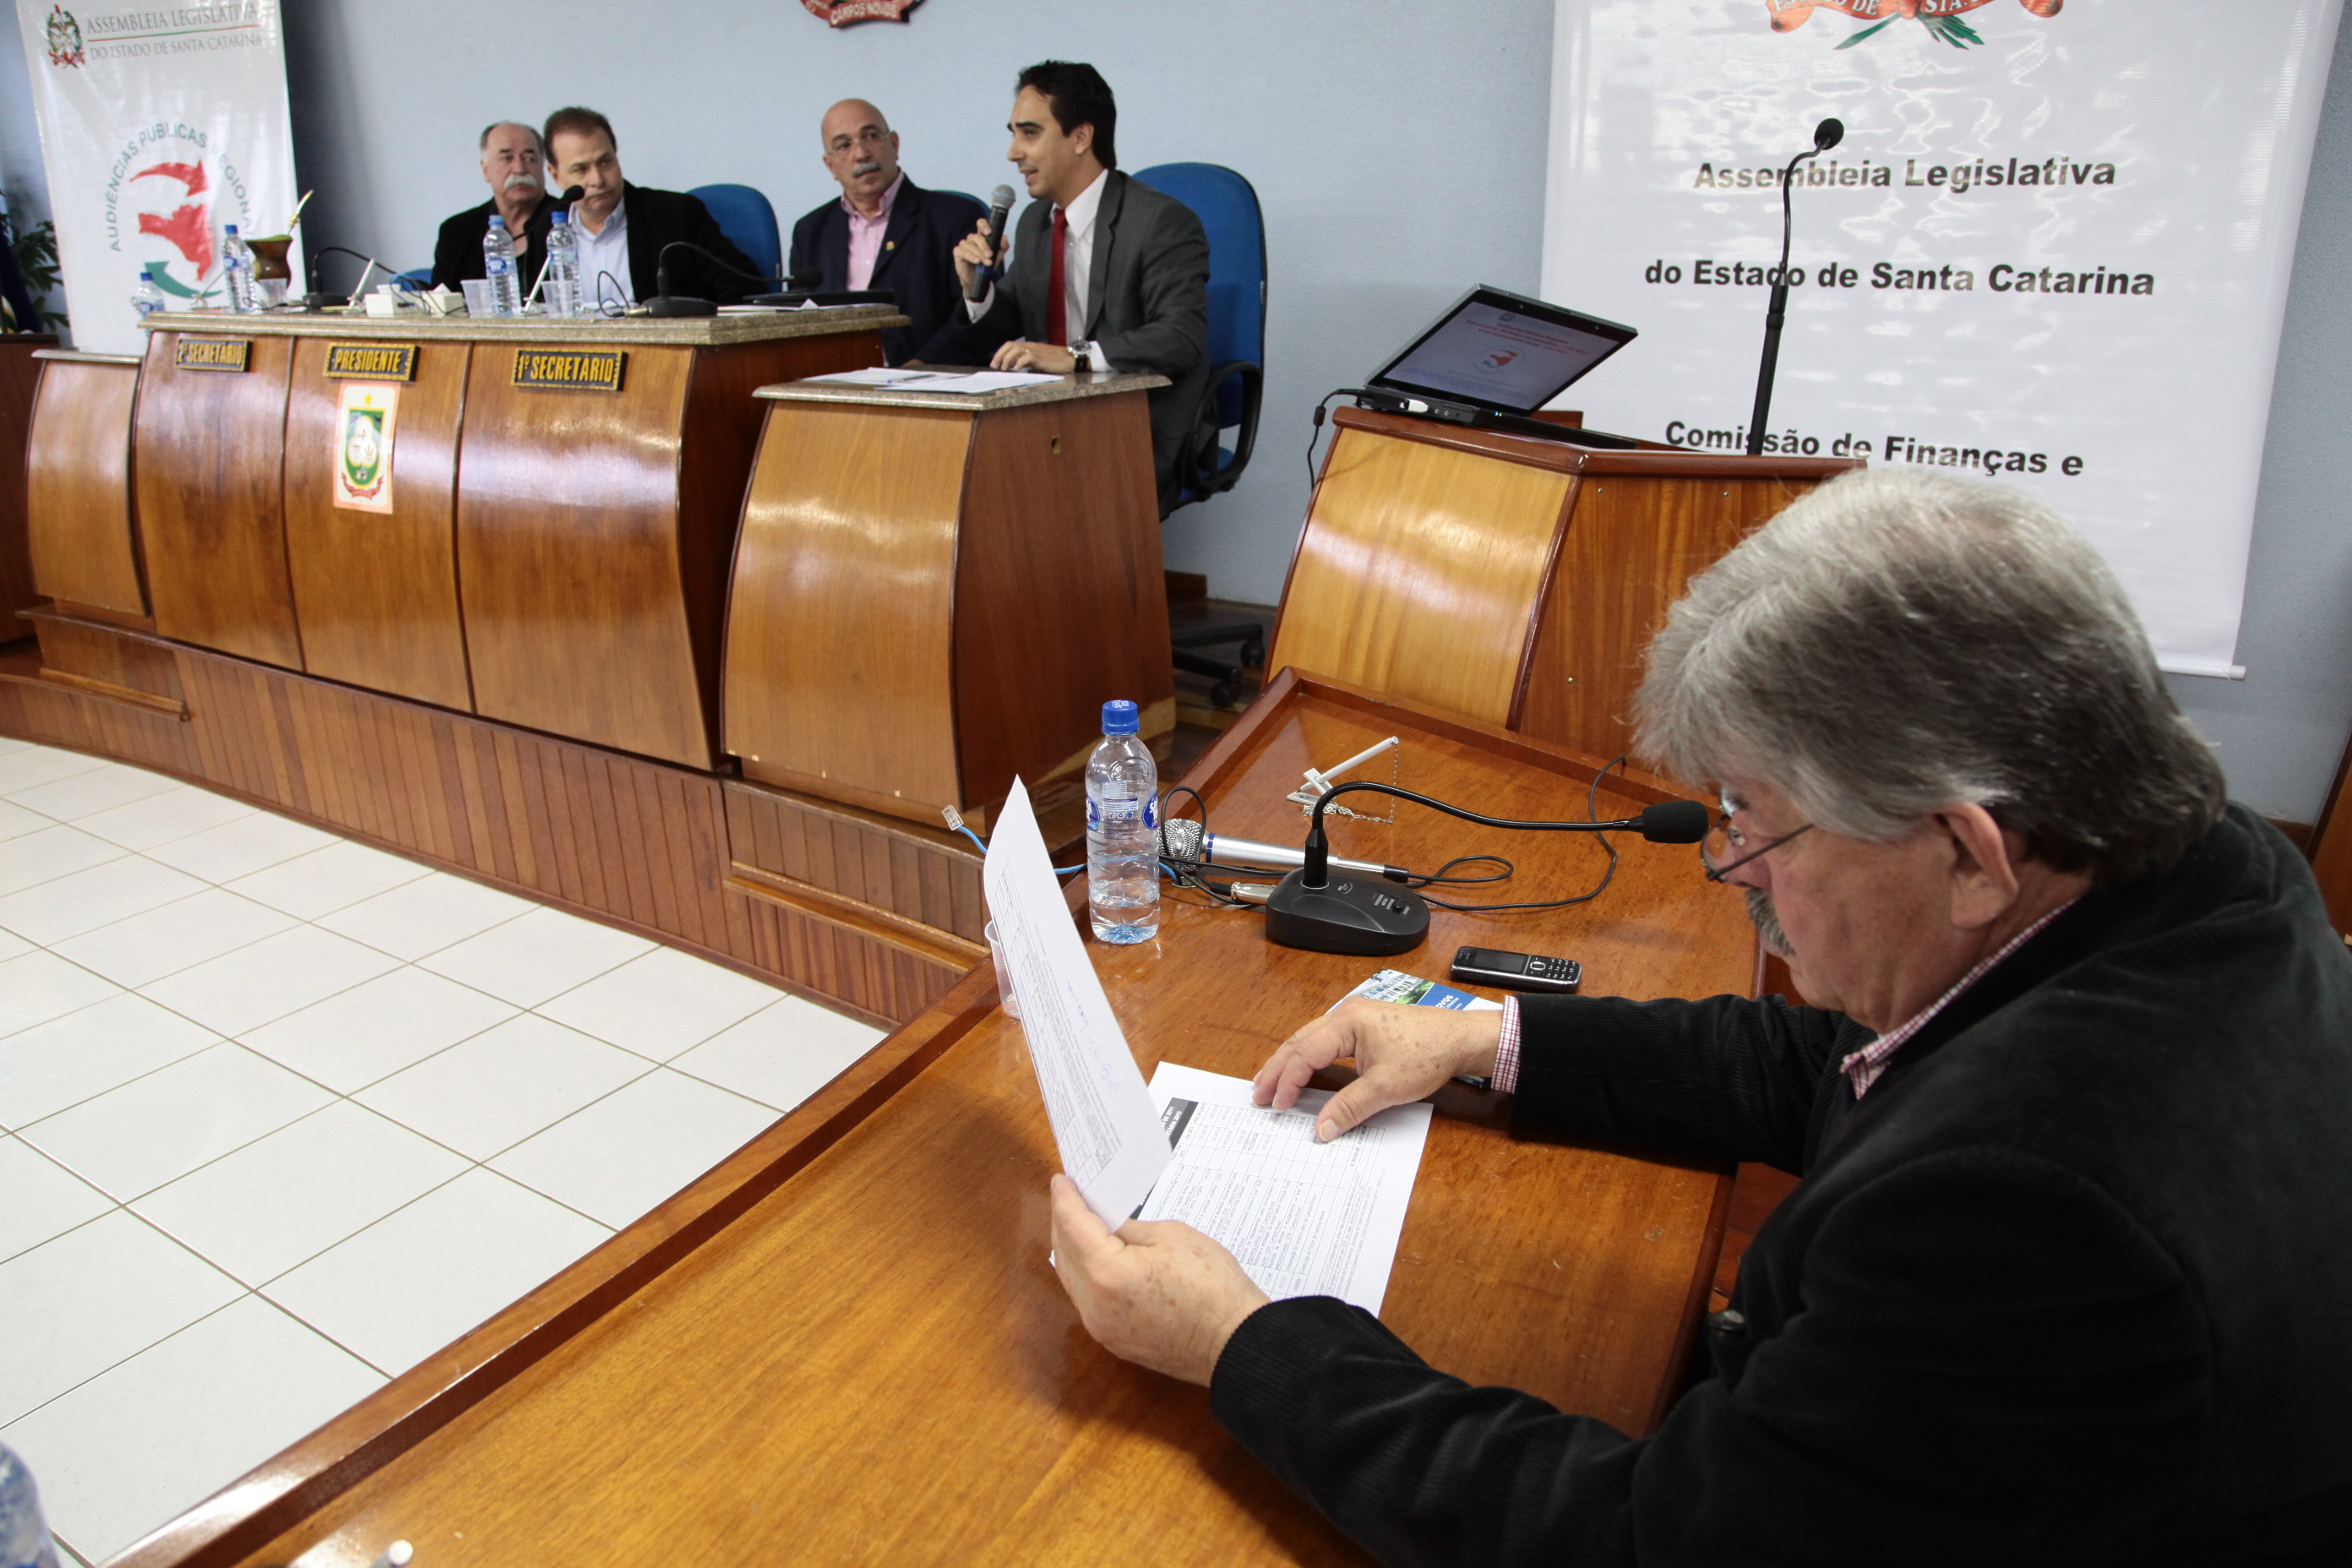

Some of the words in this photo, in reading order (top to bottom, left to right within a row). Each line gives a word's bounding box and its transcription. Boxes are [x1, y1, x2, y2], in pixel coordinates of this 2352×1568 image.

[87, 14, 168, 34] ASSEMBLEIA
[172, 3, 258, 27] LEGISLATIVA
[1851, 1, 1879, 15] DE
[90, 46, 108, 60] DO
[109, 44, 152, 58] ESTADO
[155, 41, 168, 56] DE
[172, 39, 205, 54] SANTA
[208, 34, 262, 51] CATARINA
[1693, 160, 1891, 188] Assembleia
[1905, 156, 2116, 193] Legislativa
[1646, 259, 1681, 284] do
[1818, 262, 1859, 287] de
[1870, 263, 1974, 291] Santa
[1989, 264, 2154, 295] Catarina
[334, 349, 403, 373] PRESIDENTE
[530, 354, 614, 382] SECRETÁRIO
[1832, 433, 1872, 458] de
[1885, 435, 2048, 476] Finanças
[2061, 455, 2084, 476] e
[1435, 994, 1454, 1009] ovos
